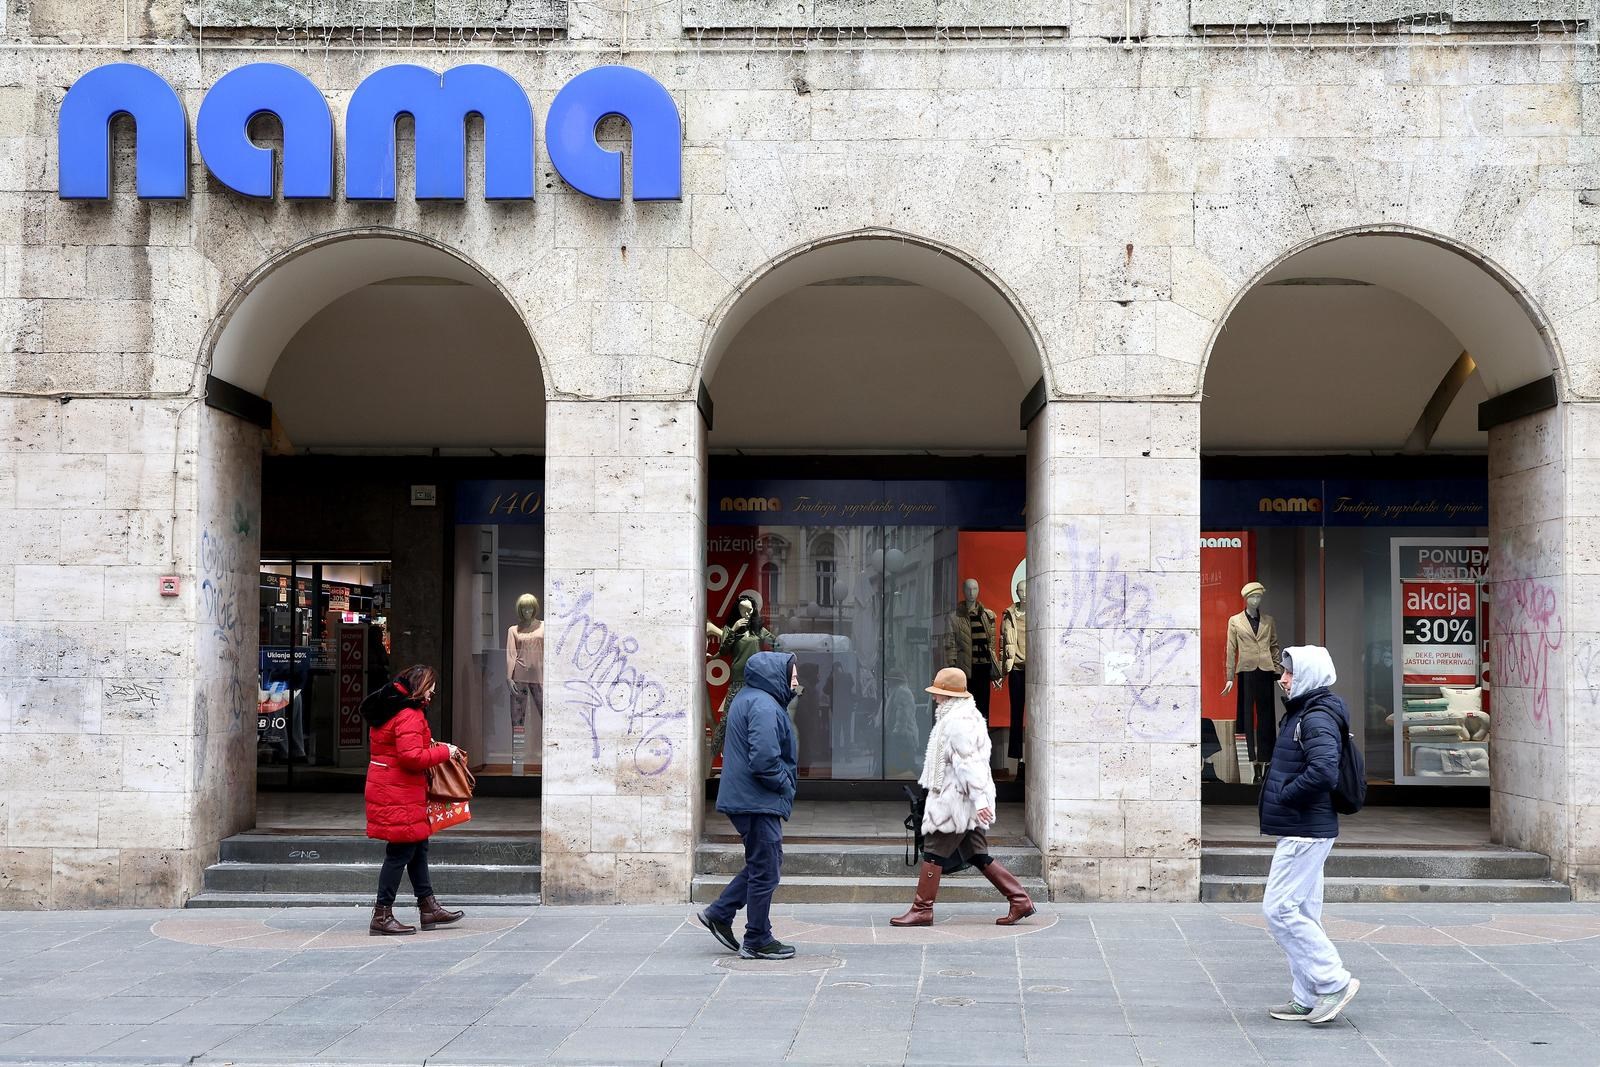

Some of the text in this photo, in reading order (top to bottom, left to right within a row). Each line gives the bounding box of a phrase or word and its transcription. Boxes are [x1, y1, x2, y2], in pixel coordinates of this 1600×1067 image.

[59, 62, 682, 202] nama
[487, 490, 541, 515] 140
[720, 496, 783, 512] nama
[1258, 496, 1323, 513] nama
[1407, 587, 1471, 616] akcija
[1405, 618, 1473, 643] -30%
